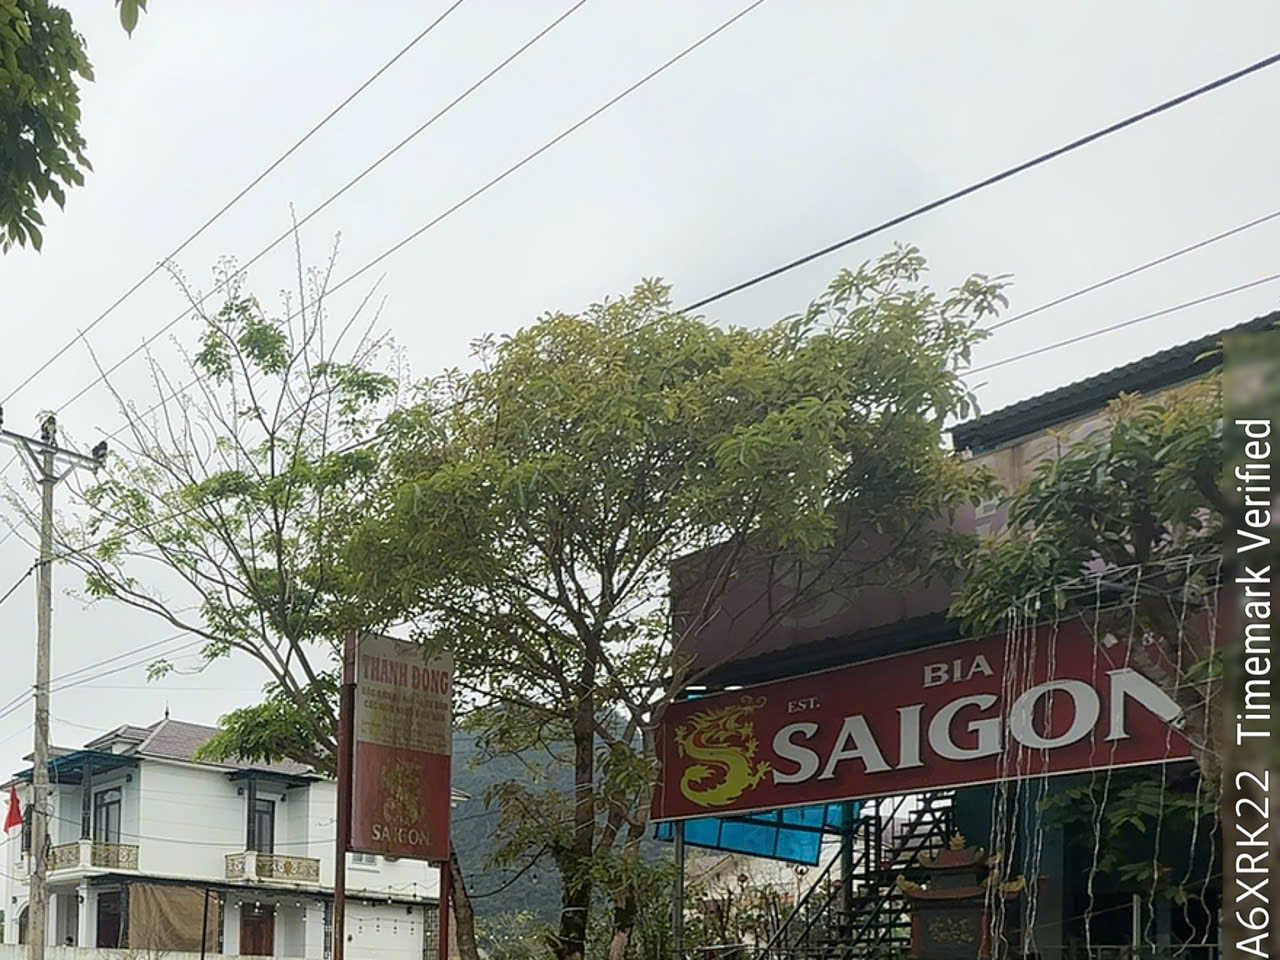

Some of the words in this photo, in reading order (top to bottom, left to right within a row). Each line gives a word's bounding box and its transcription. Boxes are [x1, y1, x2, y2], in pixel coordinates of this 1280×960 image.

[923, 655, 994, 689] BIA
[787, 695, 820, 714] EST.
[771, 667, 1186, 785] SAIGON
